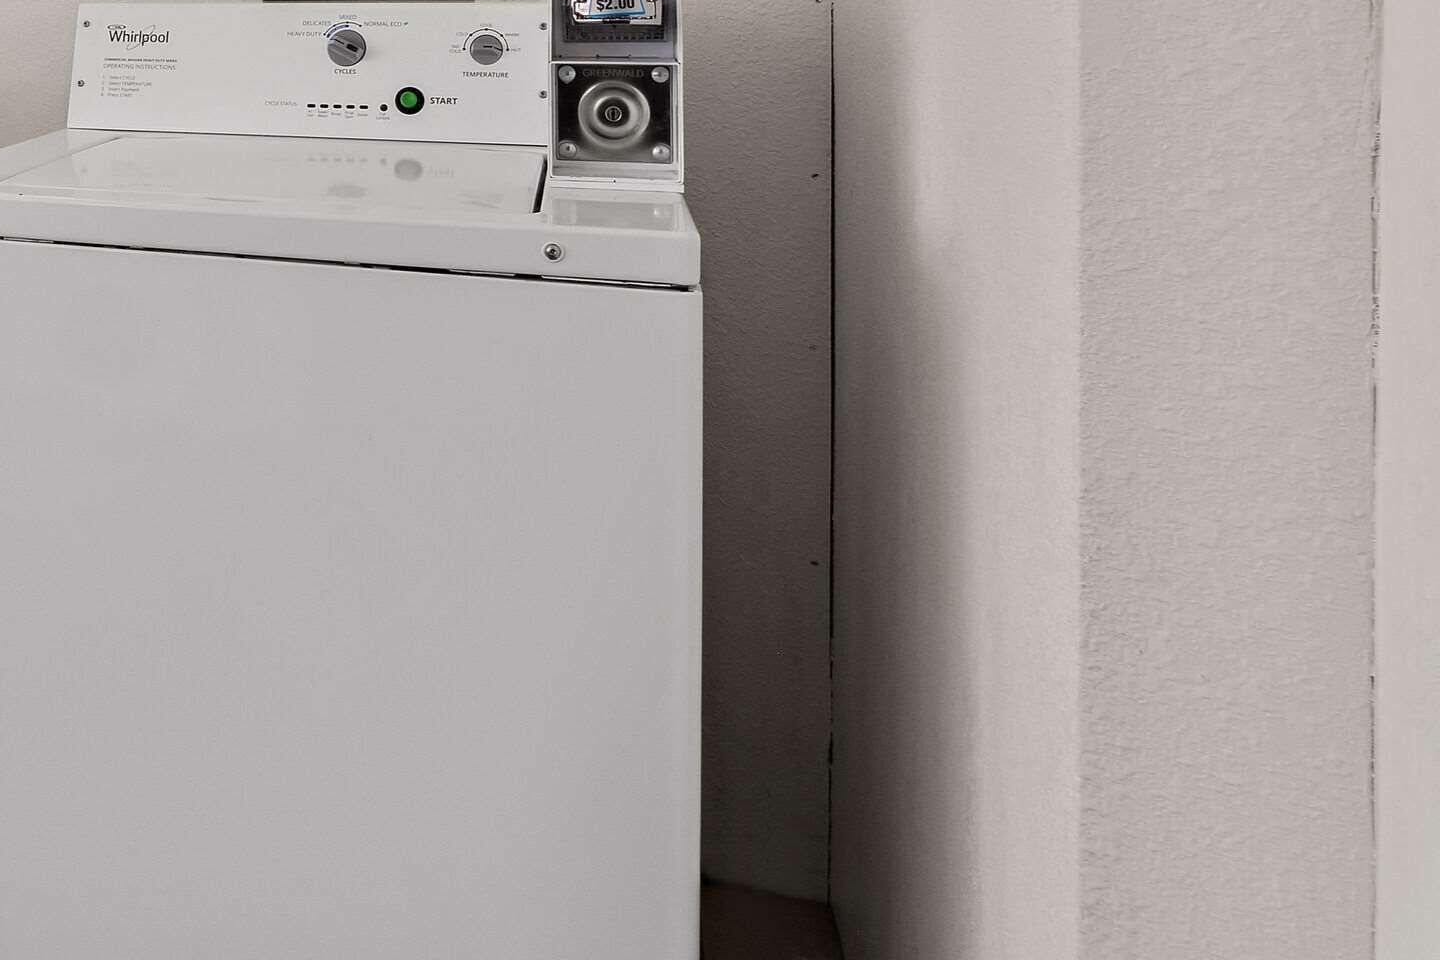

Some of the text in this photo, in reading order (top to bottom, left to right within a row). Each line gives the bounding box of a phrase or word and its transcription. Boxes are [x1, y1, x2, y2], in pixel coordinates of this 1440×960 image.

[109, 30, 170, 46] Whirlpool
[462, 71, 509, 79] TEMPERATURE
[429, 96, 458, 105] START
